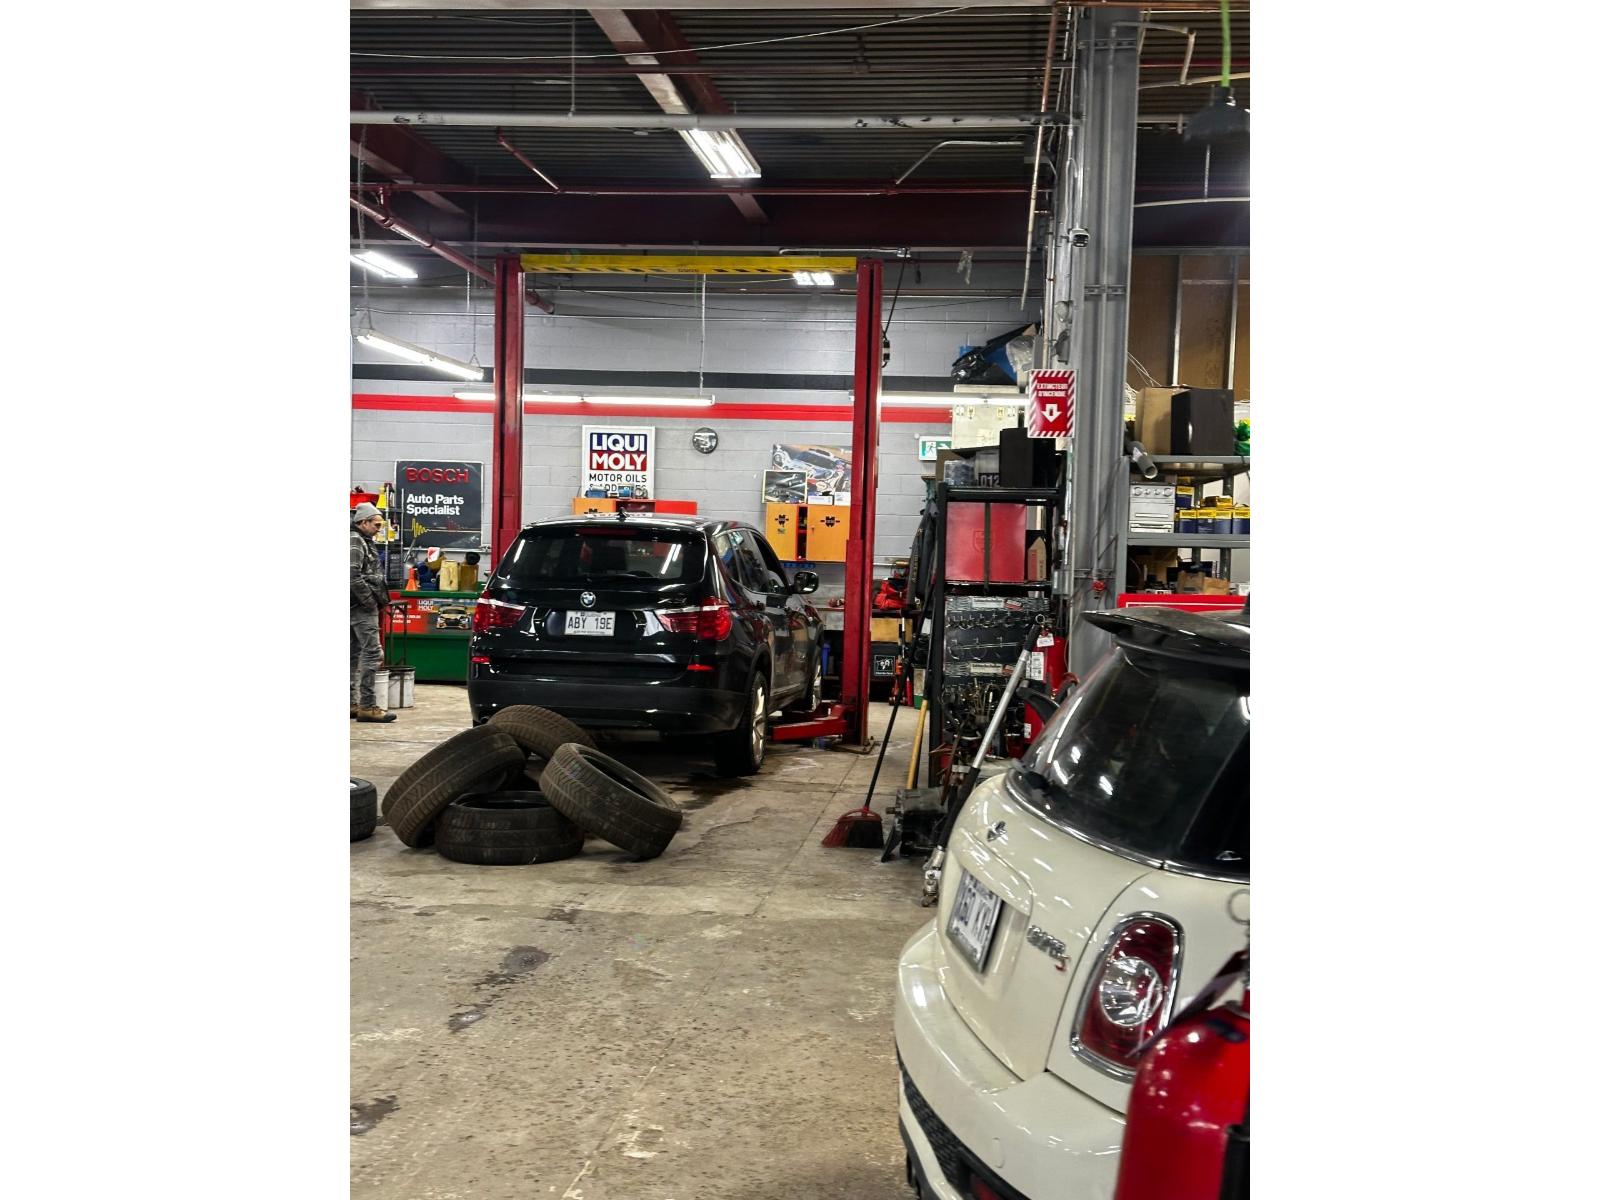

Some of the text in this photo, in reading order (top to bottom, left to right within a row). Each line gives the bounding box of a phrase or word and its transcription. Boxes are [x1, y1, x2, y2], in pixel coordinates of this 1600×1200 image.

[592, 434, 645, 452] LIQUI
[592, 452, 647, 470] MOLY
[406, 467, 470, 483] BOSCH
[589, 473, 647, 483] MOTOR OILS
[406, 493, 464, 505] Auto Parts
[406, 504, 460, 516] Specialist
[568, 616, 613, 630] ABY 19E
